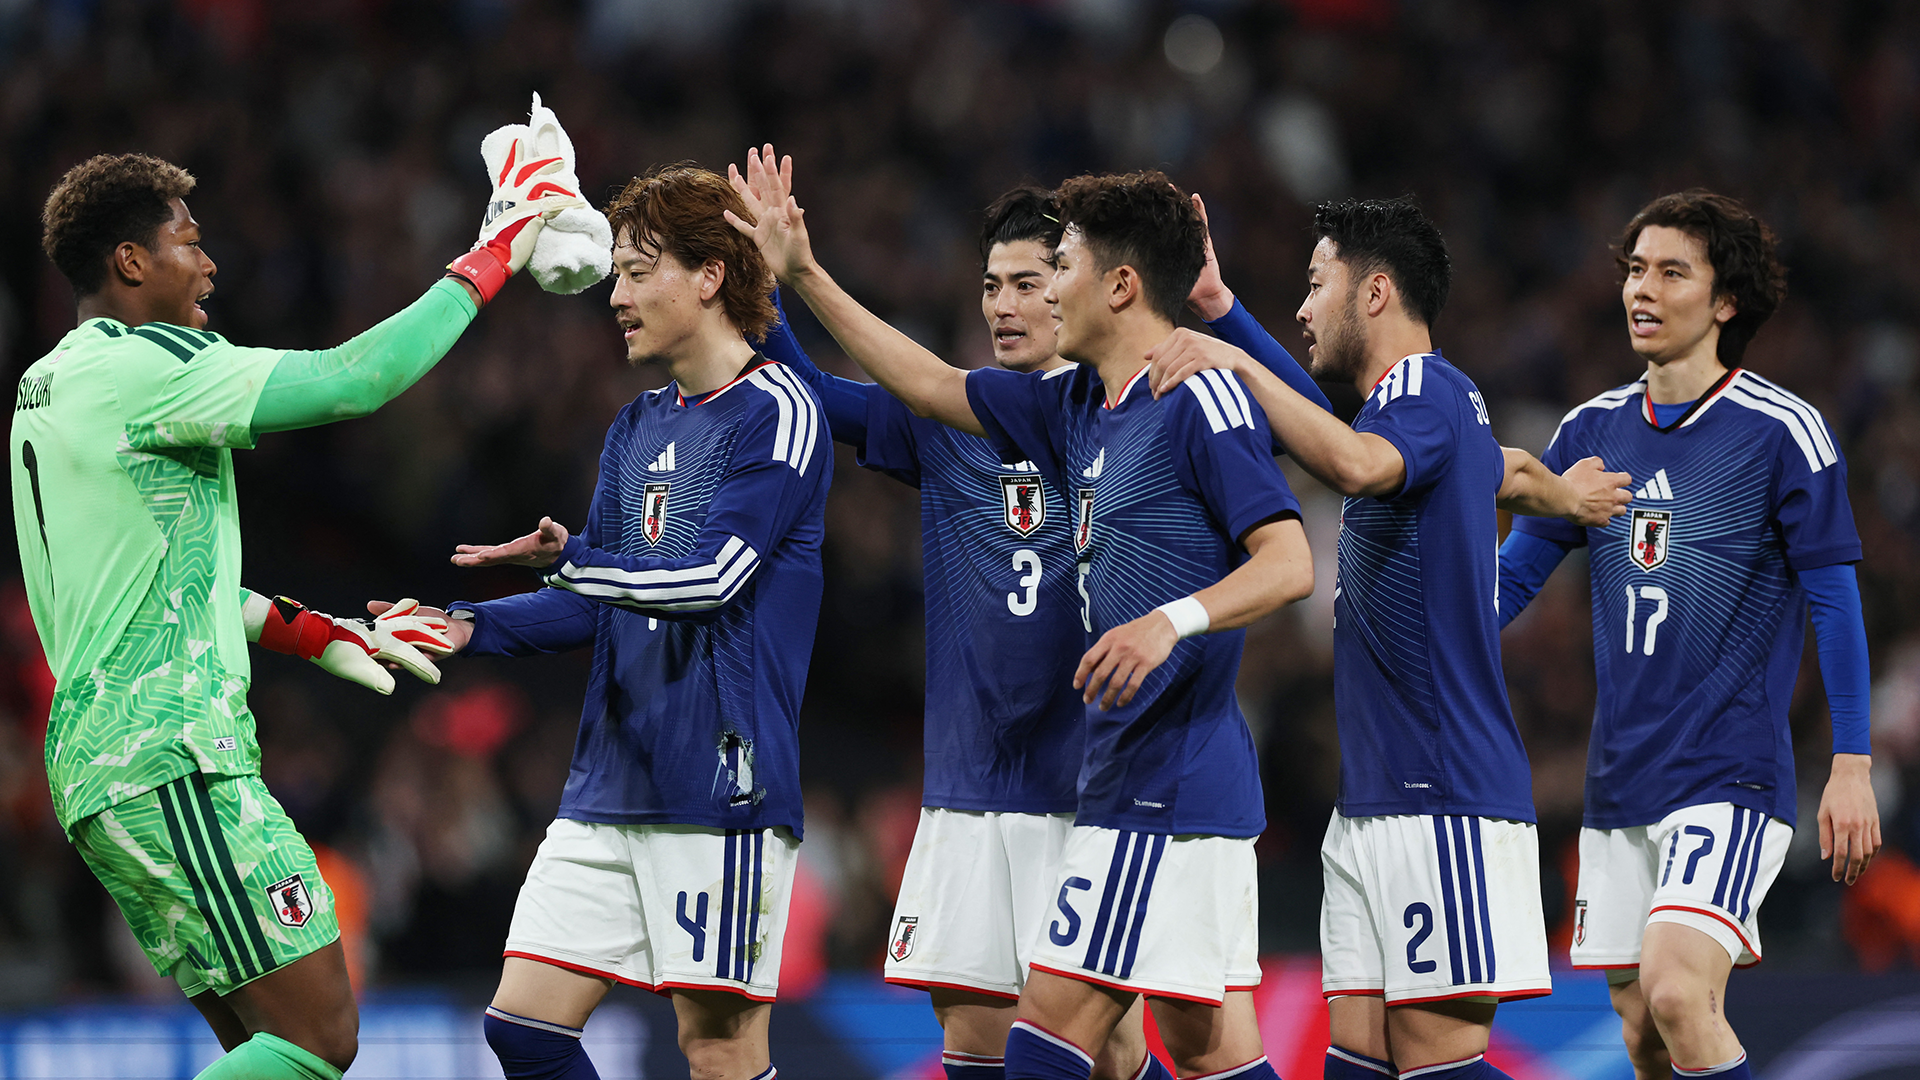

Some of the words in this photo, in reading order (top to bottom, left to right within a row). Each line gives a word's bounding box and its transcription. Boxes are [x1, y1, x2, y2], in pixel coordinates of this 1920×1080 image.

[17, 372, 54, 412] SUZUKI
[22, 439, 55, 602] 1
[1016, 515, 1035, 526] JFA
[1642, 511, 1663, 519] JAPAN
[1007, 549, 1043, 616] 3
[1640, 551, 1659, 561] JFA
[1625, 584, 1669, 656] 17
[275, 878, 293, 890] JAPAN
[1660, 825, 1715, 887] 17
[676, 891, 709, 962] 4
[1049, 876, 1092, 947] 5
[1403, 901, 1437, 974] 2
